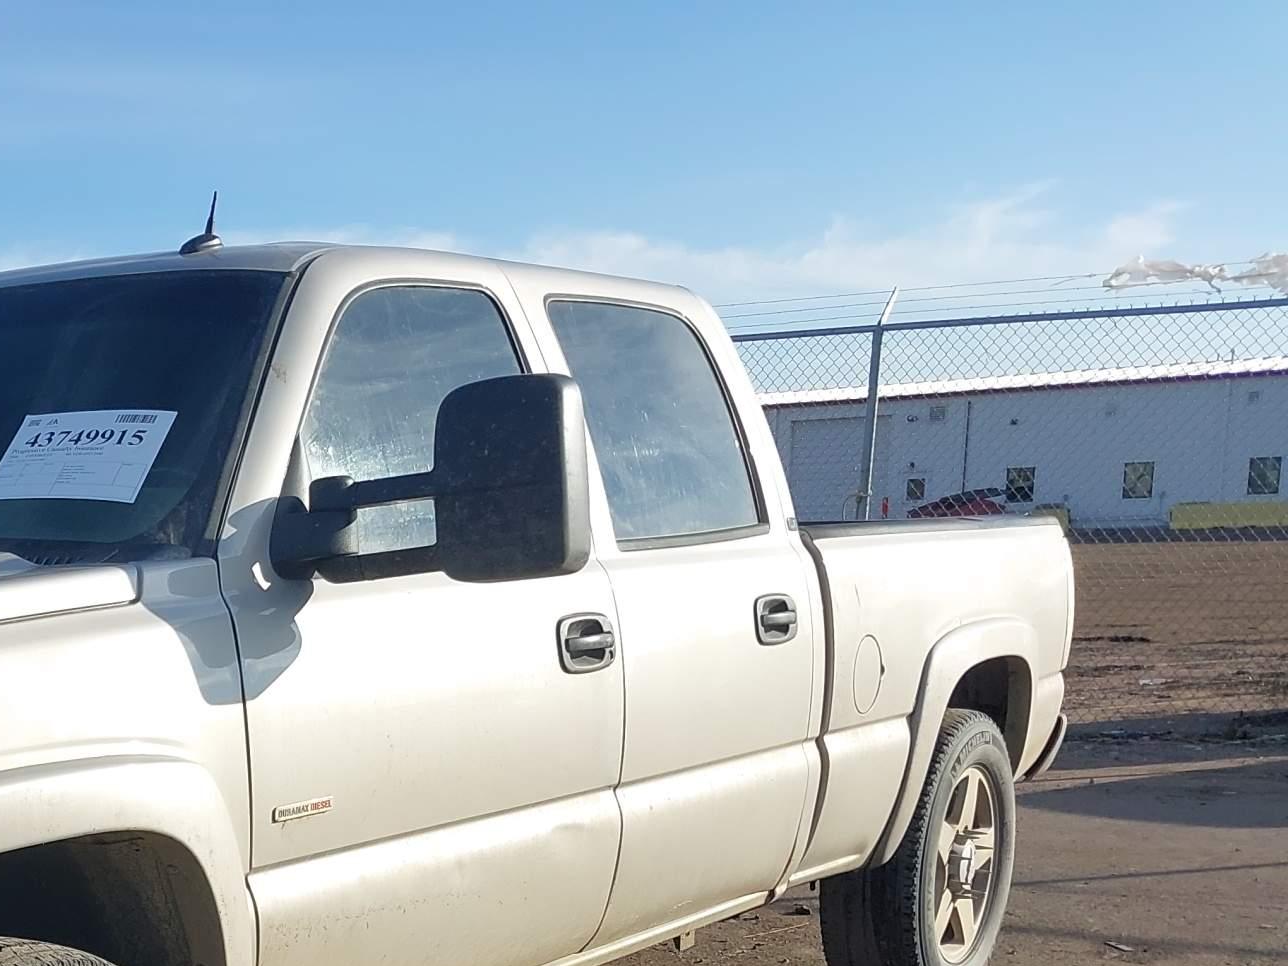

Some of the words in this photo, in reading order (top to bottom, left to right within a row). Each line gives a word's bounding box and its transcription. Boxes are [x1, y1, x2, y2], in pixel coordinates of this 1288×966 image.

[25, 429, 148, 448] 43749915
[277, 803, 310, 818] DURAMAX
[310, 799, 332, 811] DIESEL
